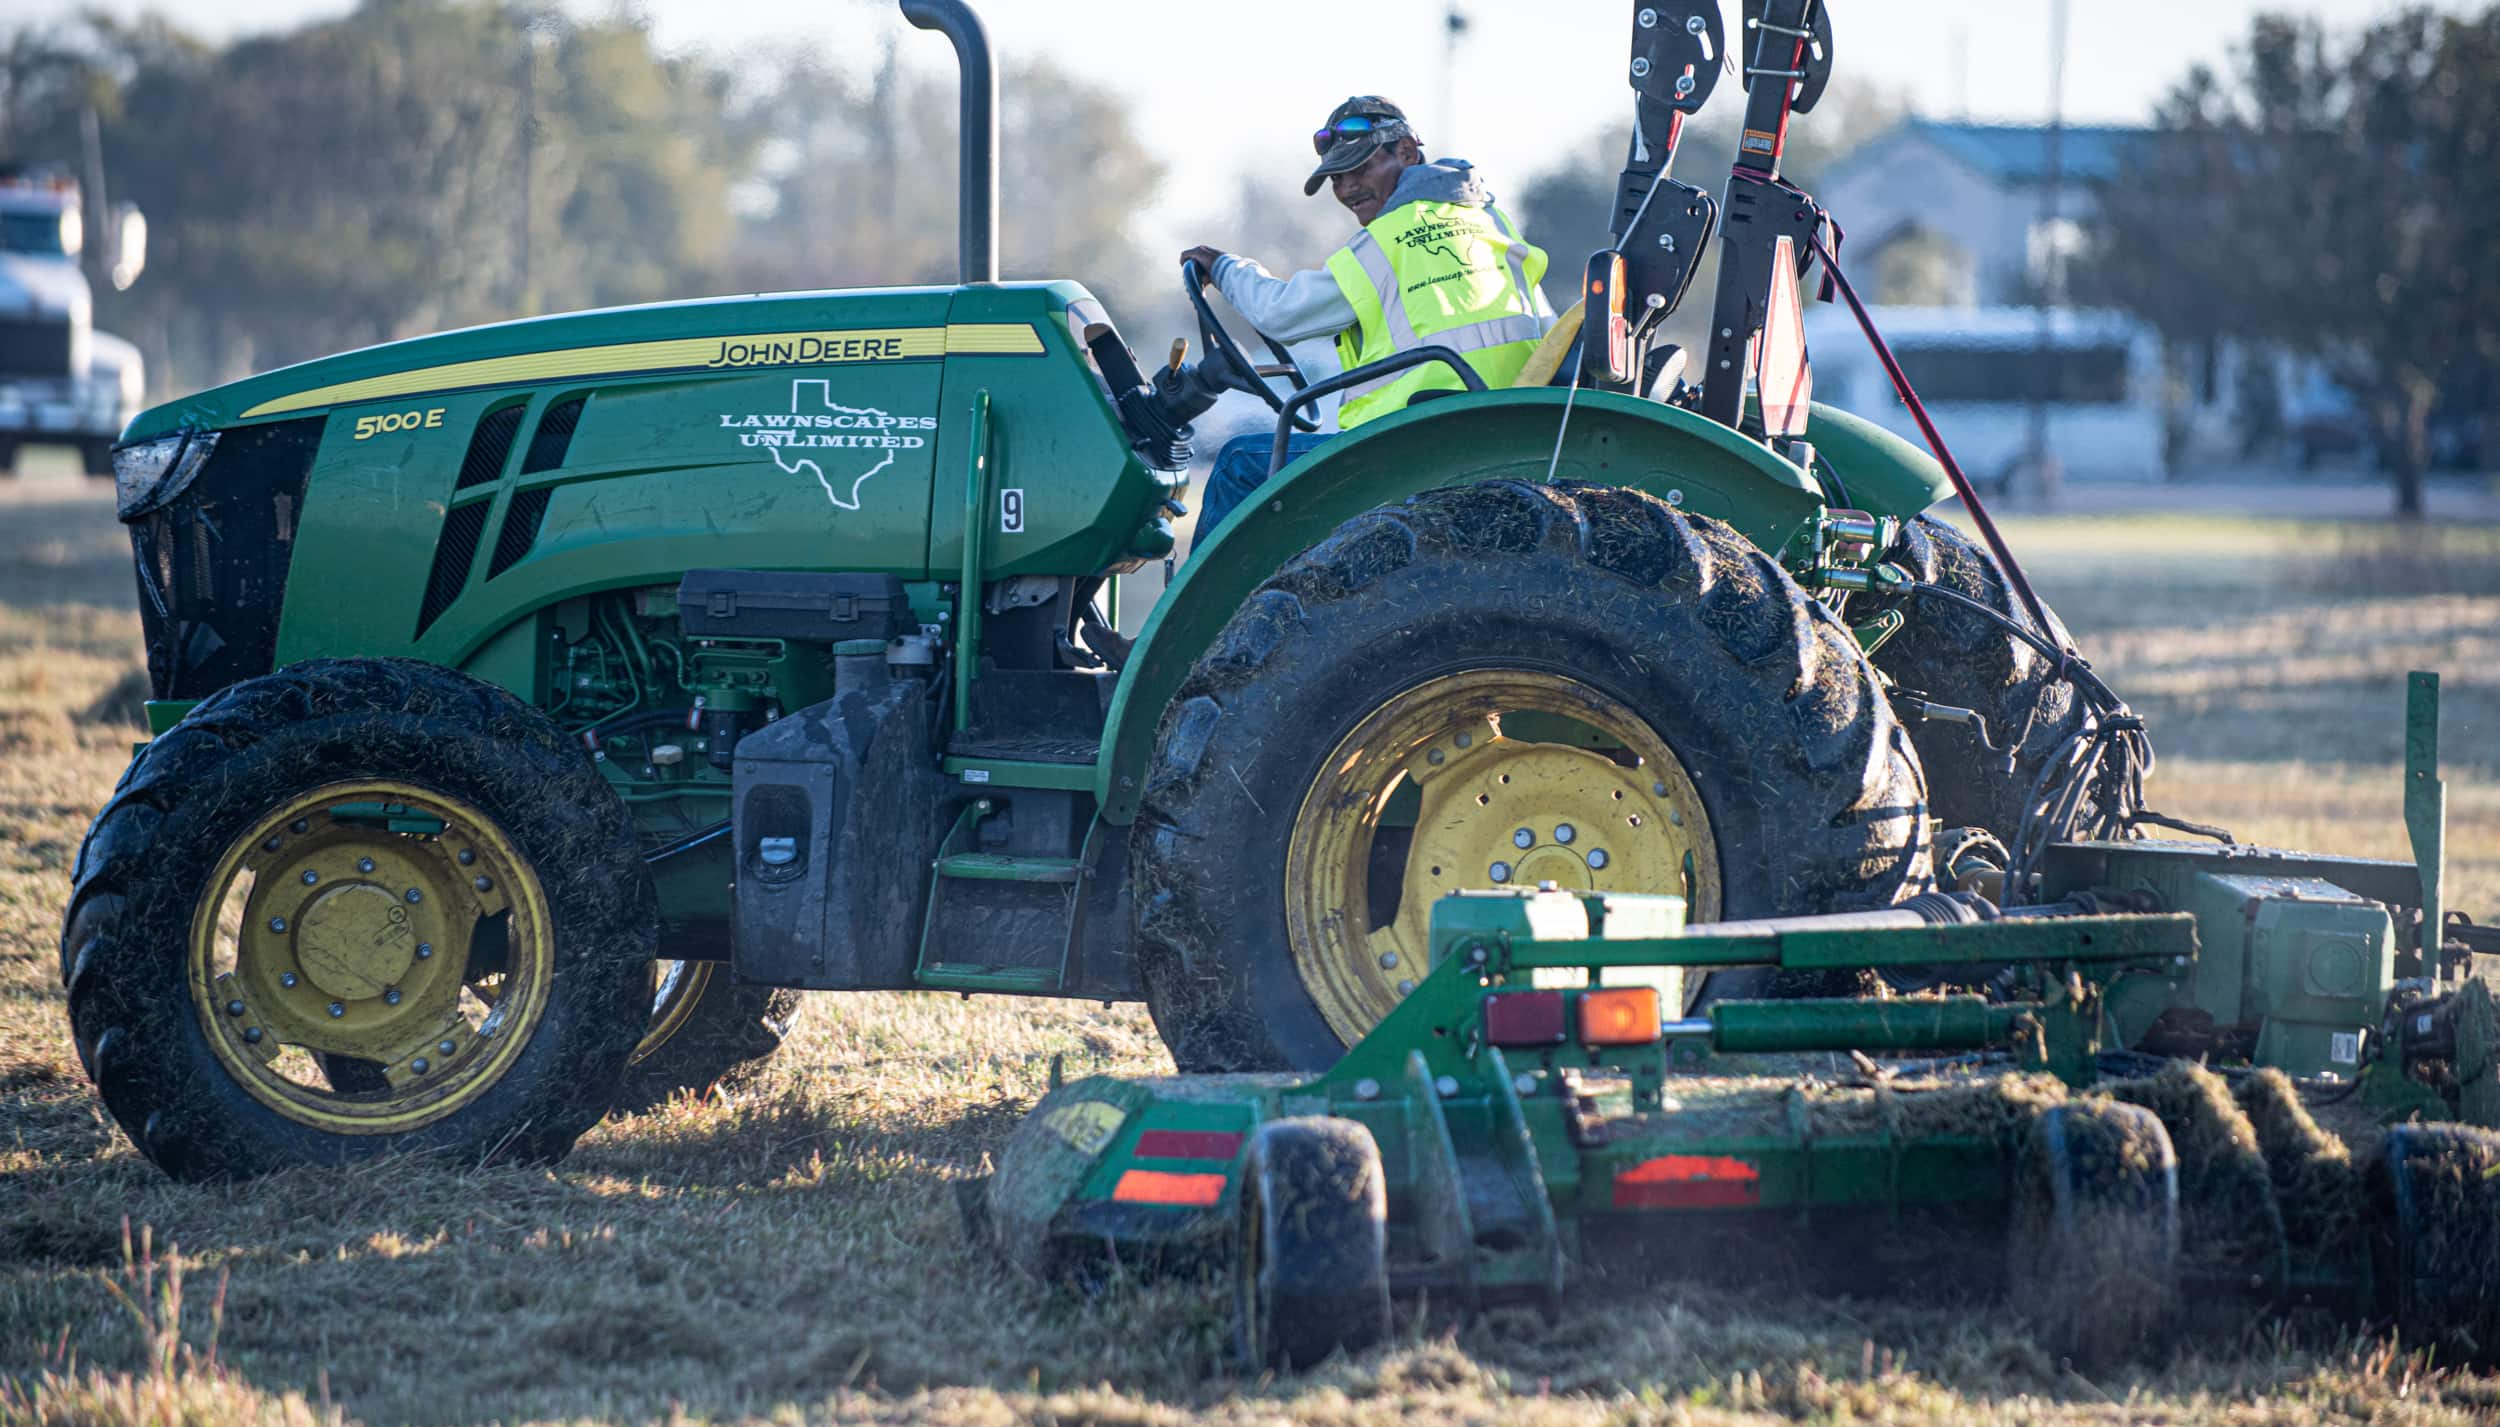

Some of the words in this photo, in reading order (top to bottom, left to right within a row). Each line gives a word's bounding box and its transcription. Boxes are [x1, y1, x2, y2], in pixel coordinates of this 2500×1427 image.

[1394, 219, 1481, 244] LAWNSCA
[709, 342, 793, 364] JOHN
[800, 338, 902, 360] DEERE
[353, 411, 422, 440] 5100
[424, 408, 446, 428] E
[720, 414, 938, 430] LAWNSCAPES
[738, 433, 925, 449] UNLIMITED
[1003, 490, 1022, 531] 9
